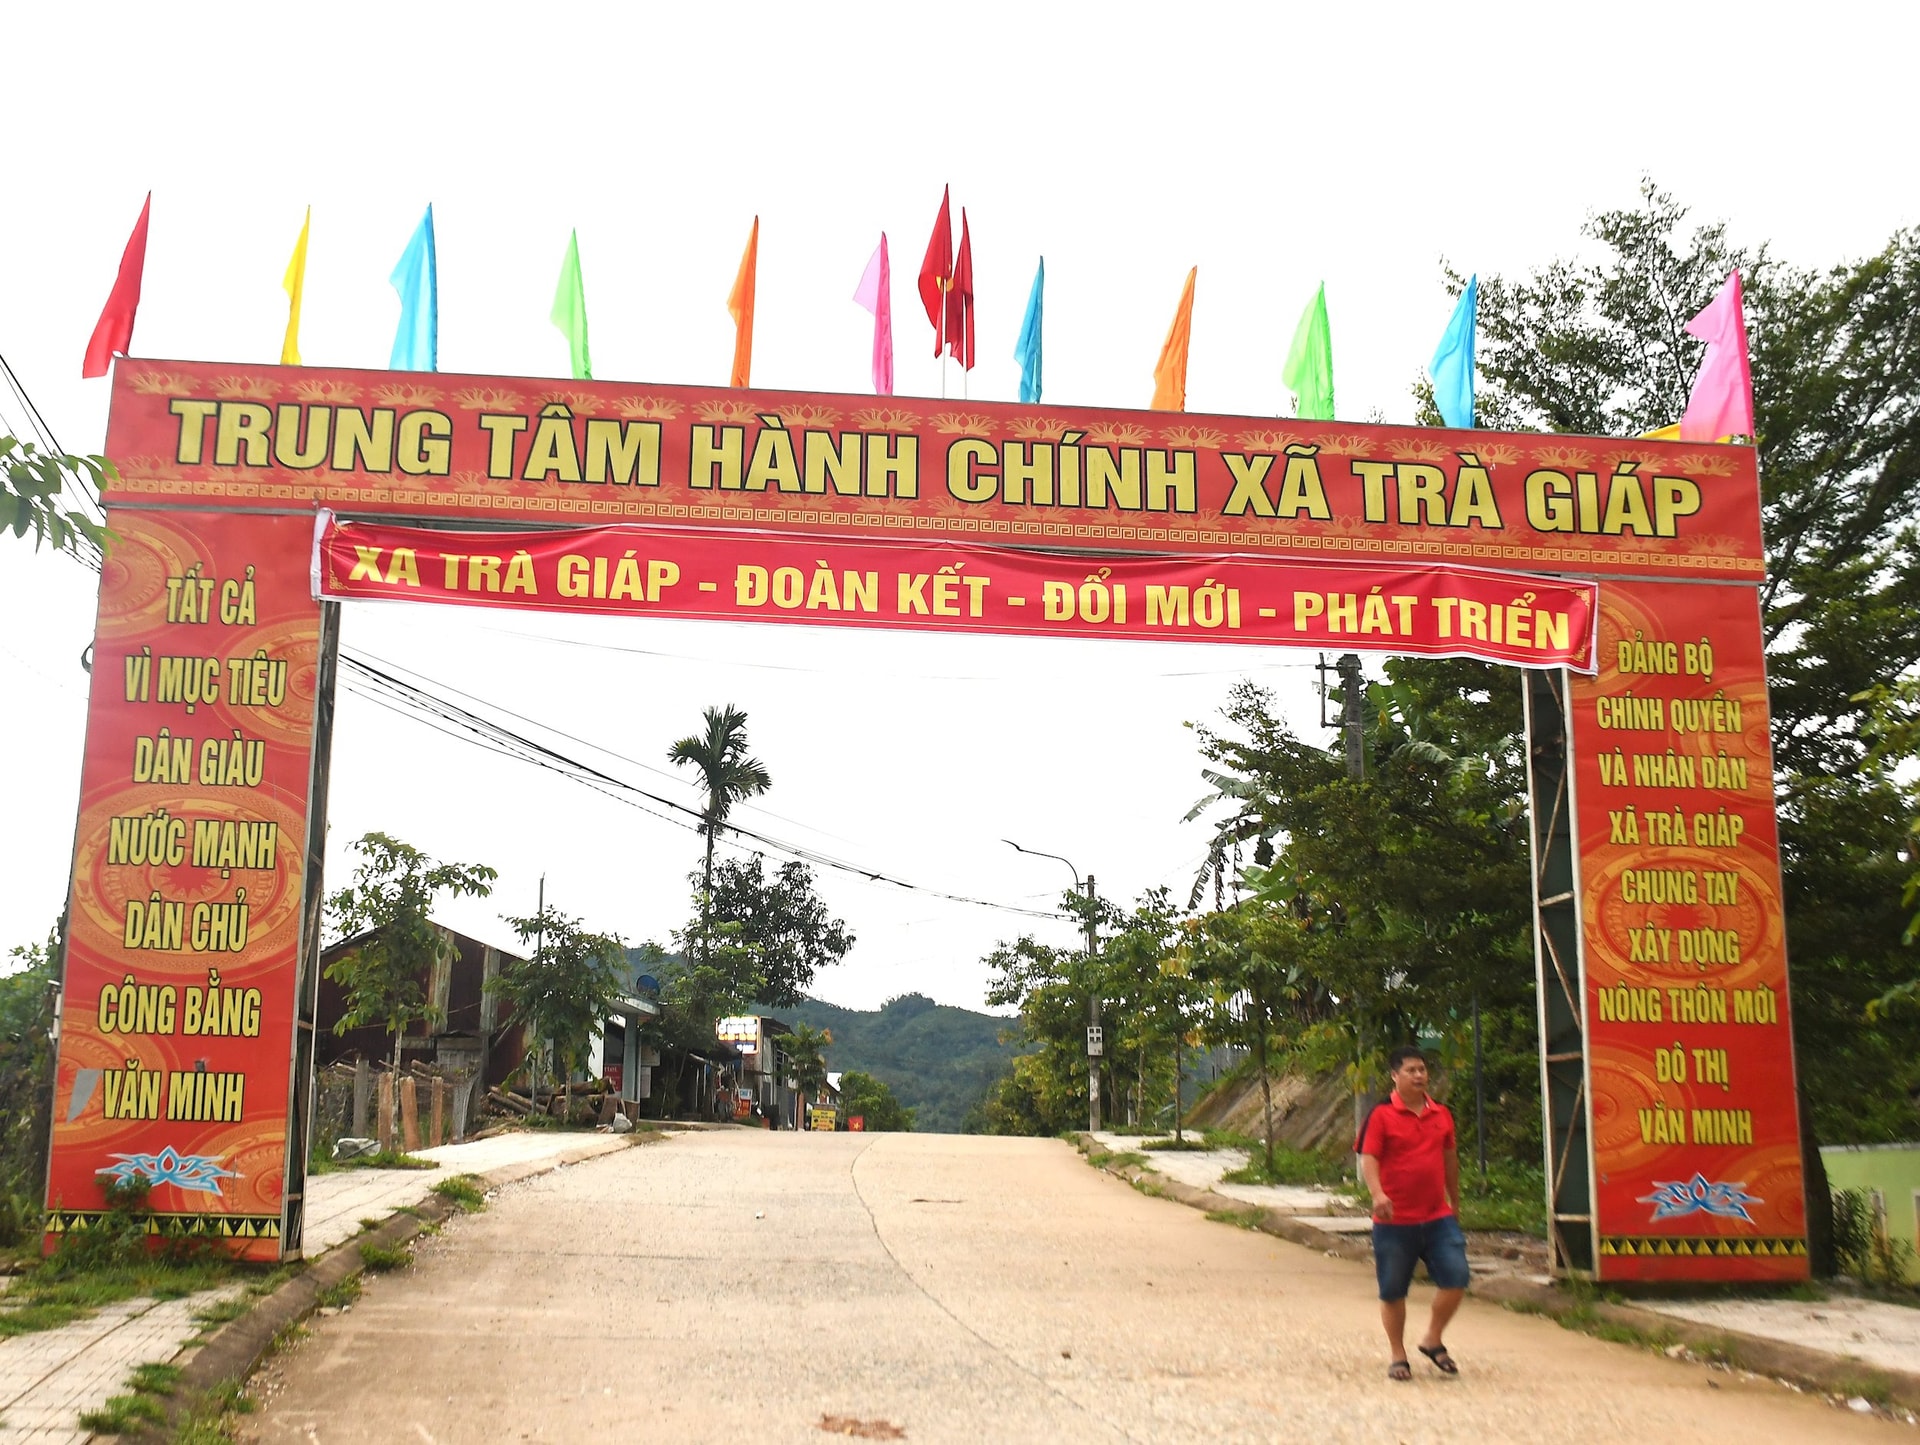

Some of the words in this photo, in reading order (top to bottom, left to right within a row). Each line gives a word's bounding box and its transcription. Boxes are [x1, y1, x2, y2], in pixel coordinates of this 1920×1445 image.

[169, 399, 454, 476] TRUNG
[481, 403, 662, 487] TÂM
[688, 414, 920, 499] HÀNH
[945, 431, 1197, 514] CHÍNH
[1223, 444, 1331, 520] XÃ
[1352, 452, 1502, 529] TRÀ
[1525, 461, 1702, 538] GIÁP
[166, 562, 215, 625] TẤT
[219, 564, 256, 626] CẢ
[439, 550, 538, 595] TRÀ
[555, 550, 681, 602] GIÁP
[735, 559, 879, 613] ĐOÀN
[897, 561, 991, 618] KẾT
[1042, 567, 1128, 625] ĐỔI
[1145, 578, 1240, 629] MỚI
[1294, 586, 1419, 636] PHÁT
[1431, 592, 1569, 650] TRIỂN
[125, 646, 152, 703] VÌ
[157, 655, 220, 714] MỤC
[227, 650, 288, 708] TIÊU
[1618, 630, 1678, 675] ĐẢNG
[1684, 636, 1713, 684] BỘ
[1596, 691, 1664, 731] CHÍNH
[1670, 689, 1742, 736] QUYỀN
[133, 727, 194, 785] DÂN
[199, 730, 265, 787] GIÀU
[1598, 746, 1628, 788] VÀ
[1634, 748, 1696, 789] NHÂN
[1702, 750, 1748, 790] DÂN
[108, 809, 186, 867] NƯỚC
[192, 821, 277, 879] MẠNH
[1608, 804, 1641, 845] XÃ
[1644, 806, 1690, 847] TRÀ
[1694, 806, 1744, 848] GIÁP
[1621, 869, 1697, 905] CHUNG
[1704, 871, 1740, 906] TAY
[124, 891, 185, 950] DÂN
[190, 887, 249, 953] CHỦ
[1628, 921, 1671, 964] XÂY
[1678, 927, 1741, 972] DỰNG
[98, 974, 178, 1035] CÔNG
[183, 968, 262, 1037] BẰNG
[1598, 979, 1662, 1023] NÔNG
[1667, 981, 1728, 1024] THÔN
[103, 1059, 162, 1120] VĂN
[167, 1070, 245, 1122] MINH
[1655, 1041, 1686, 1084] ĐÔ
[1691, 1048, 1729, 1093] THỊ
[1638, 1100, 1686, 1145] VĂN
[1692, 1109, 1753, 1145] MINH
